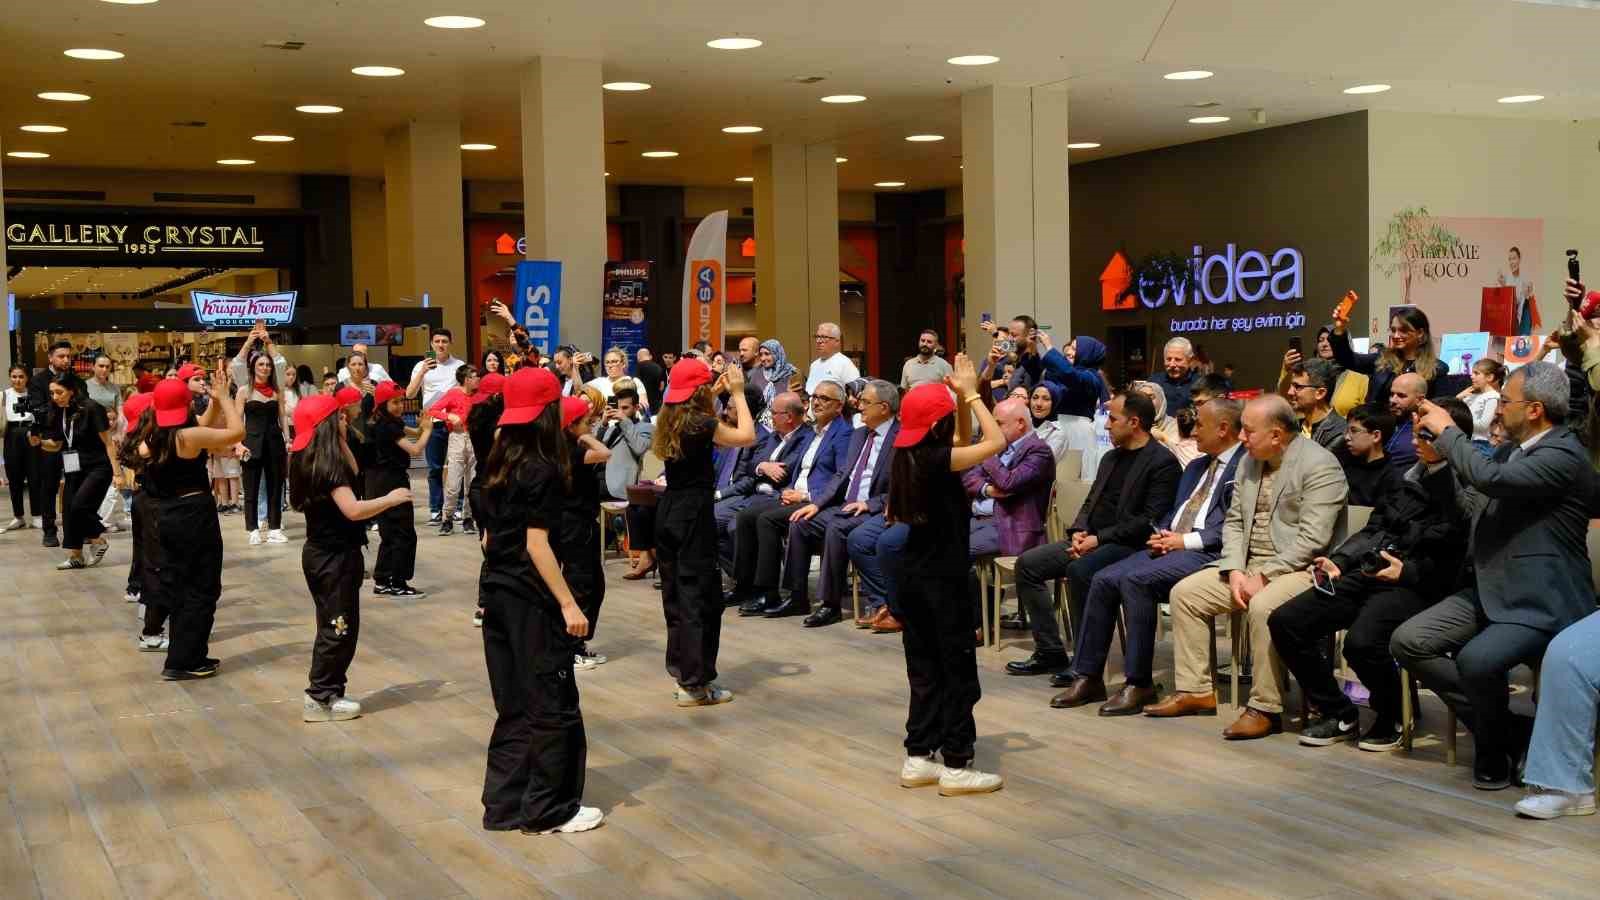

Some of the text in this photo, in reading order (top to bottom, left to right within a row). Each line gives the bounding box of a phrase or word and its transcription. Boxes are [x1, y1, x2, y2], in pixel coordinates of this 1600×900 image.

[7, 223, 264, 246] GALLERY CRYSTAL
[123, 243, 157, 255] 1955
[615, 268, 648, 277] PHILIPS
[202, 298, 289, 317] Krispy Kreme
[1170, 316, 1208, 332] burada
[1211, 315, 1229, 330] her
[1231, 317, 1253, 333] şey
[1255, 312, 1283, 329] evim
